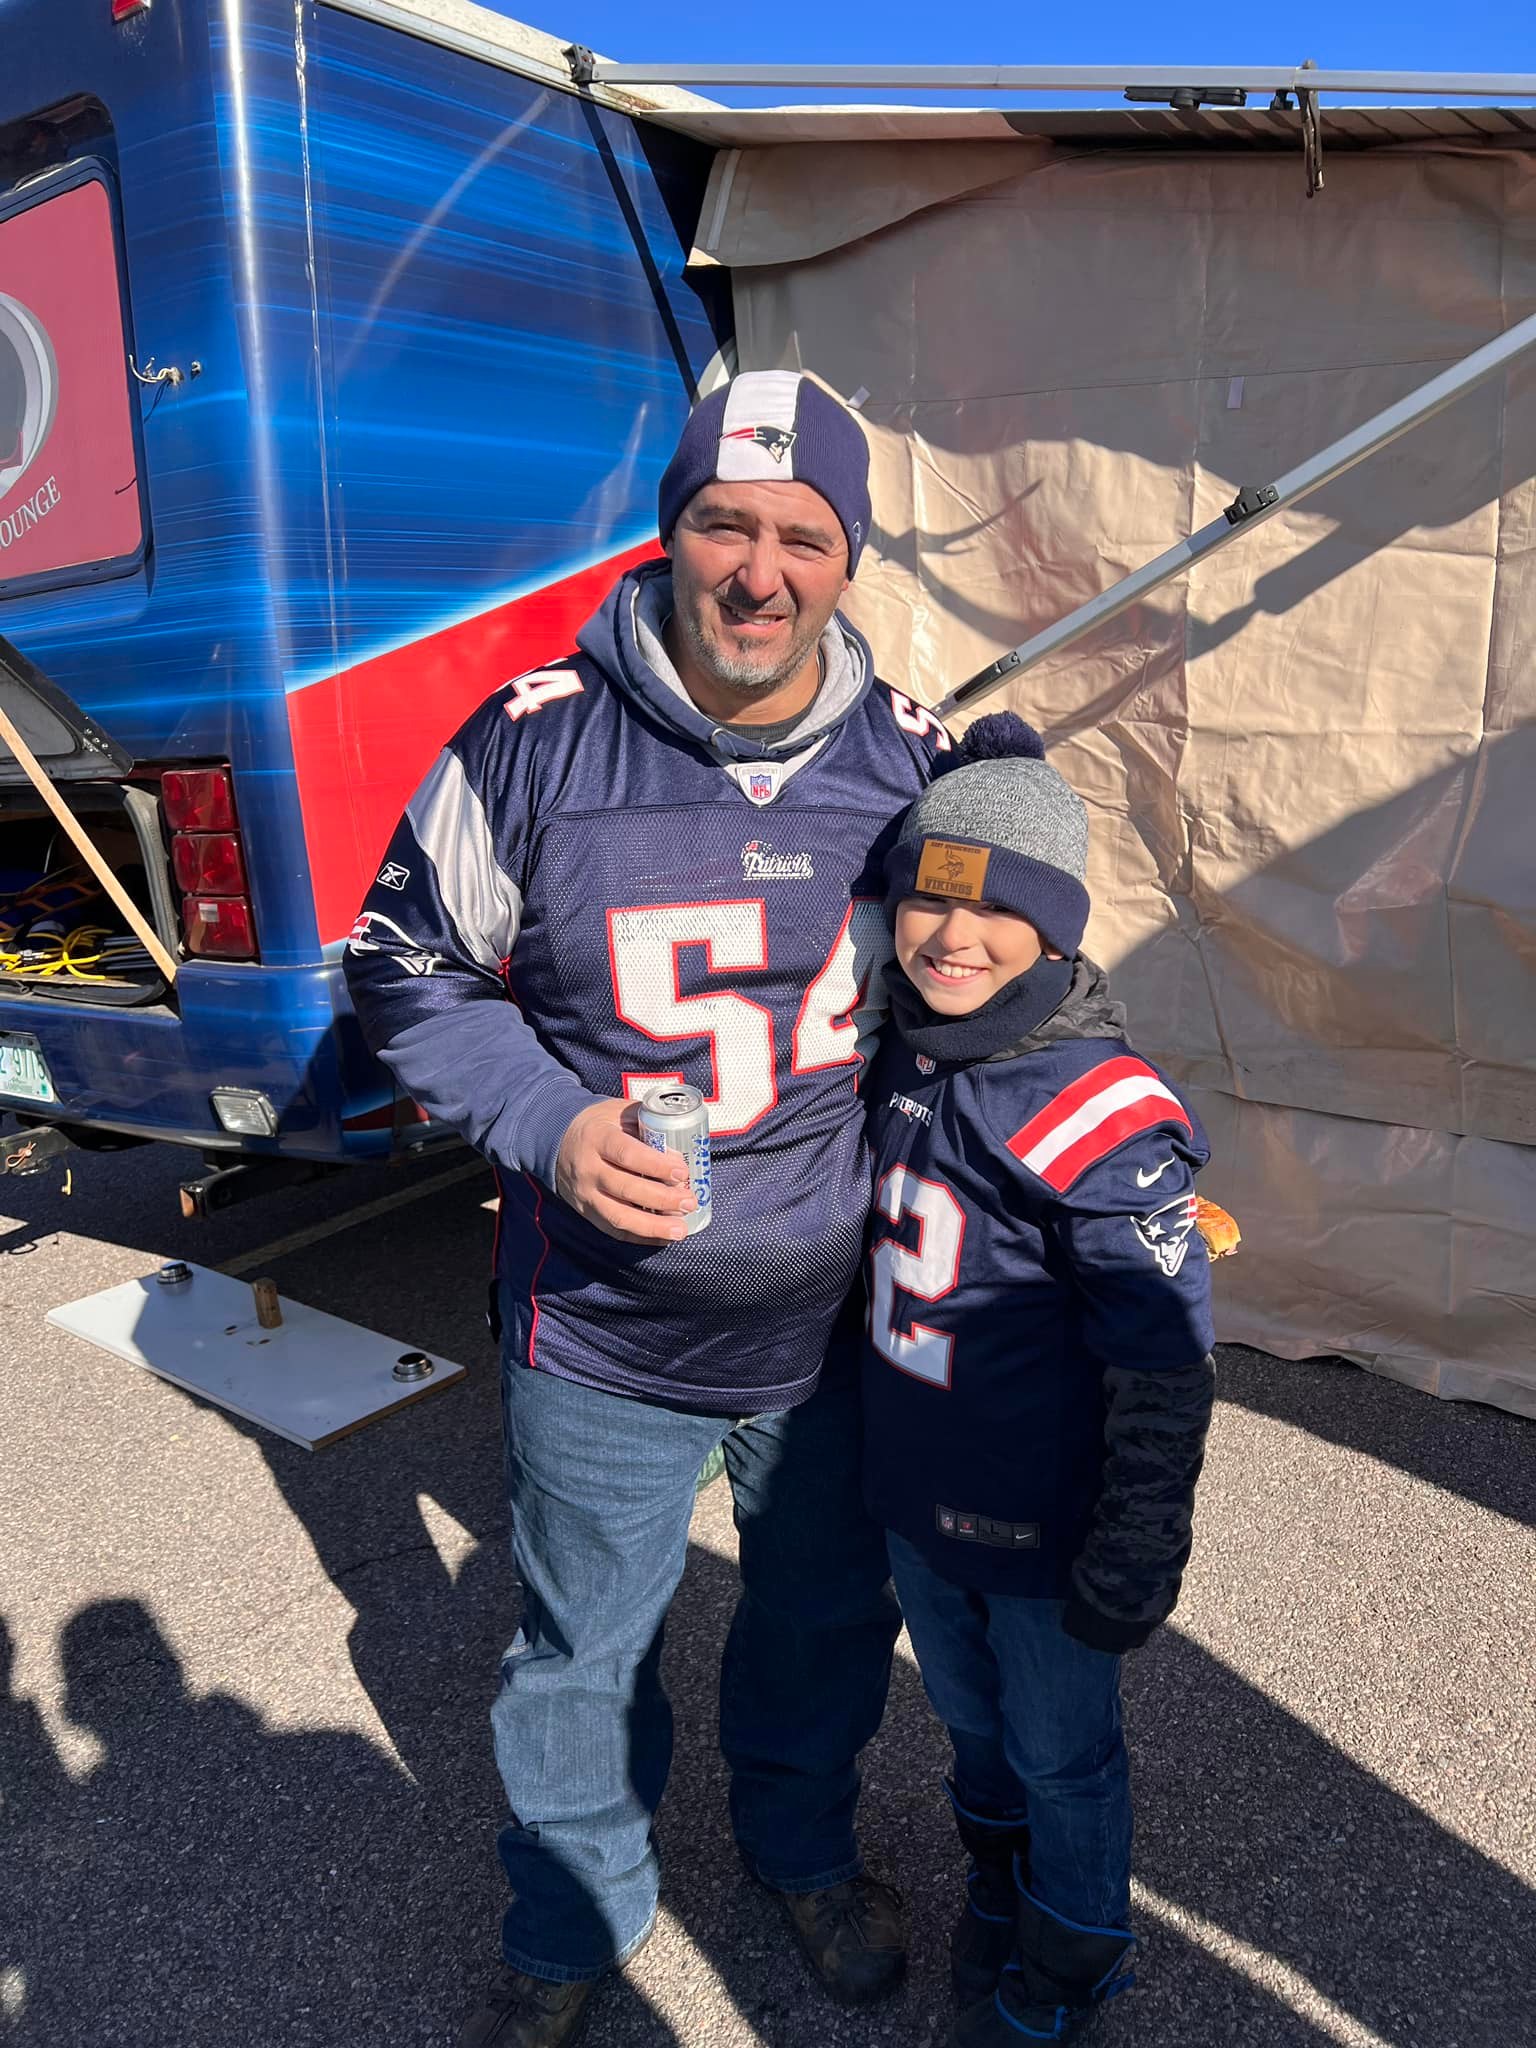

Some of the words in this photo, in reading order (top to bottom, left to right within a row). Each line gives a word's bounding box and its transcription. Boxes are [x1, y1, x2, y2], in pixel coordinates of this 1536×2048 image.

[498, 660, 585, 722] 4
[742, 851, 815, 879] Patriots
[925, 878, 973, 895] VIKINGS
[606, 896, 890, 1136] 54
[869, 1162, 966, 1391] 2
